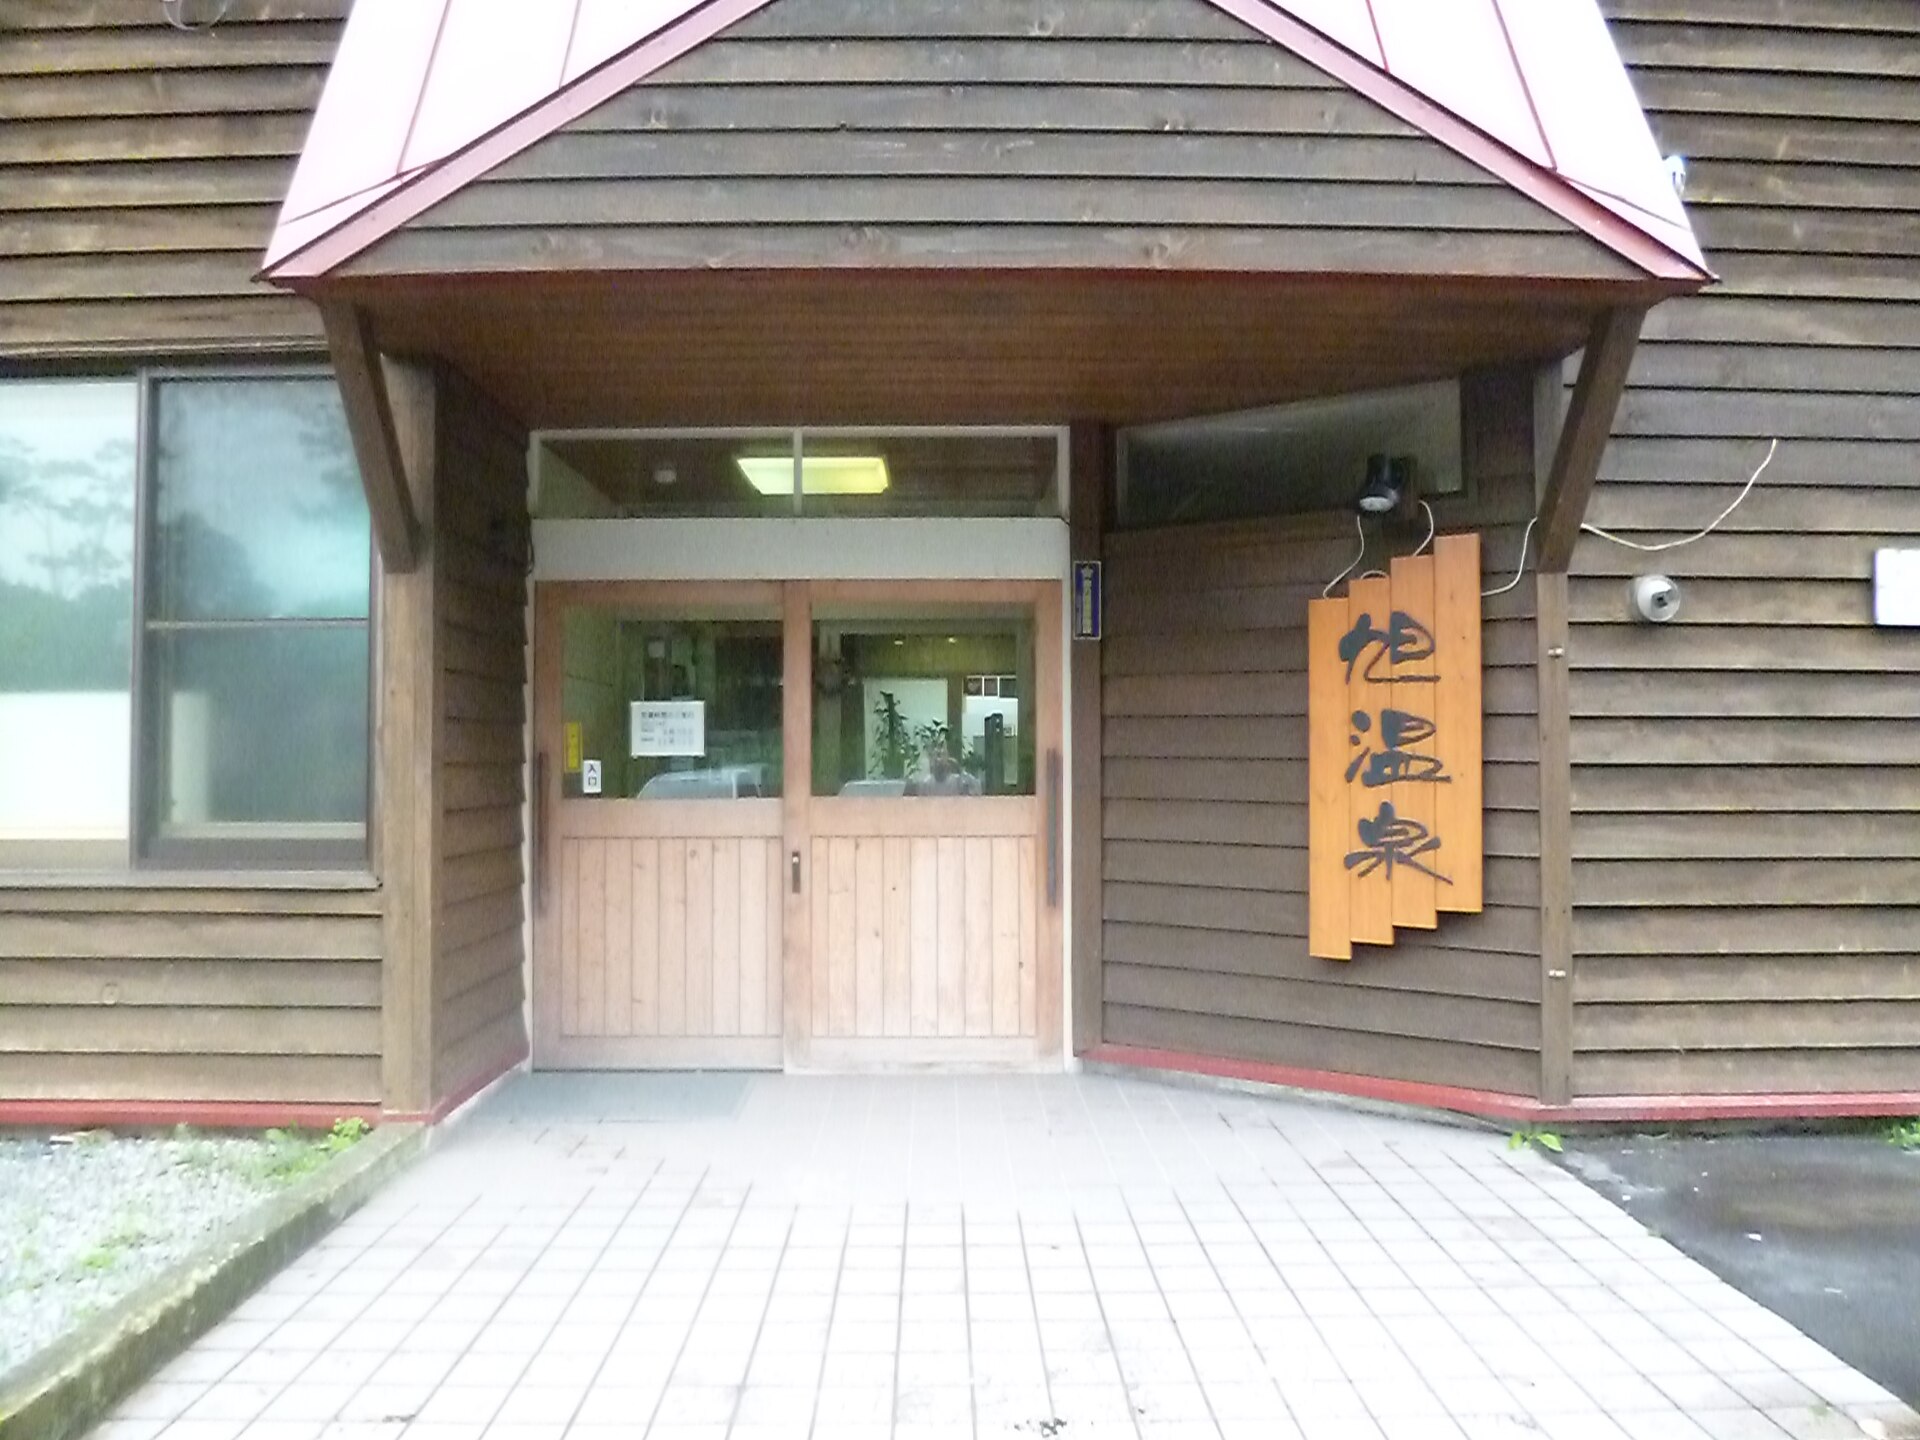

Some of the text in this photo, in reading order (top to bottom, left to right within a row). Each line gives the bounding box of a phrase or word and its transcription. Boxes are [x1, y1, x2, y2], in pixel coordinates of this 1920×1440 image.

[588, 763, 597, 786] 入口
[1339, 611, 1453, 884] 旭温泉
